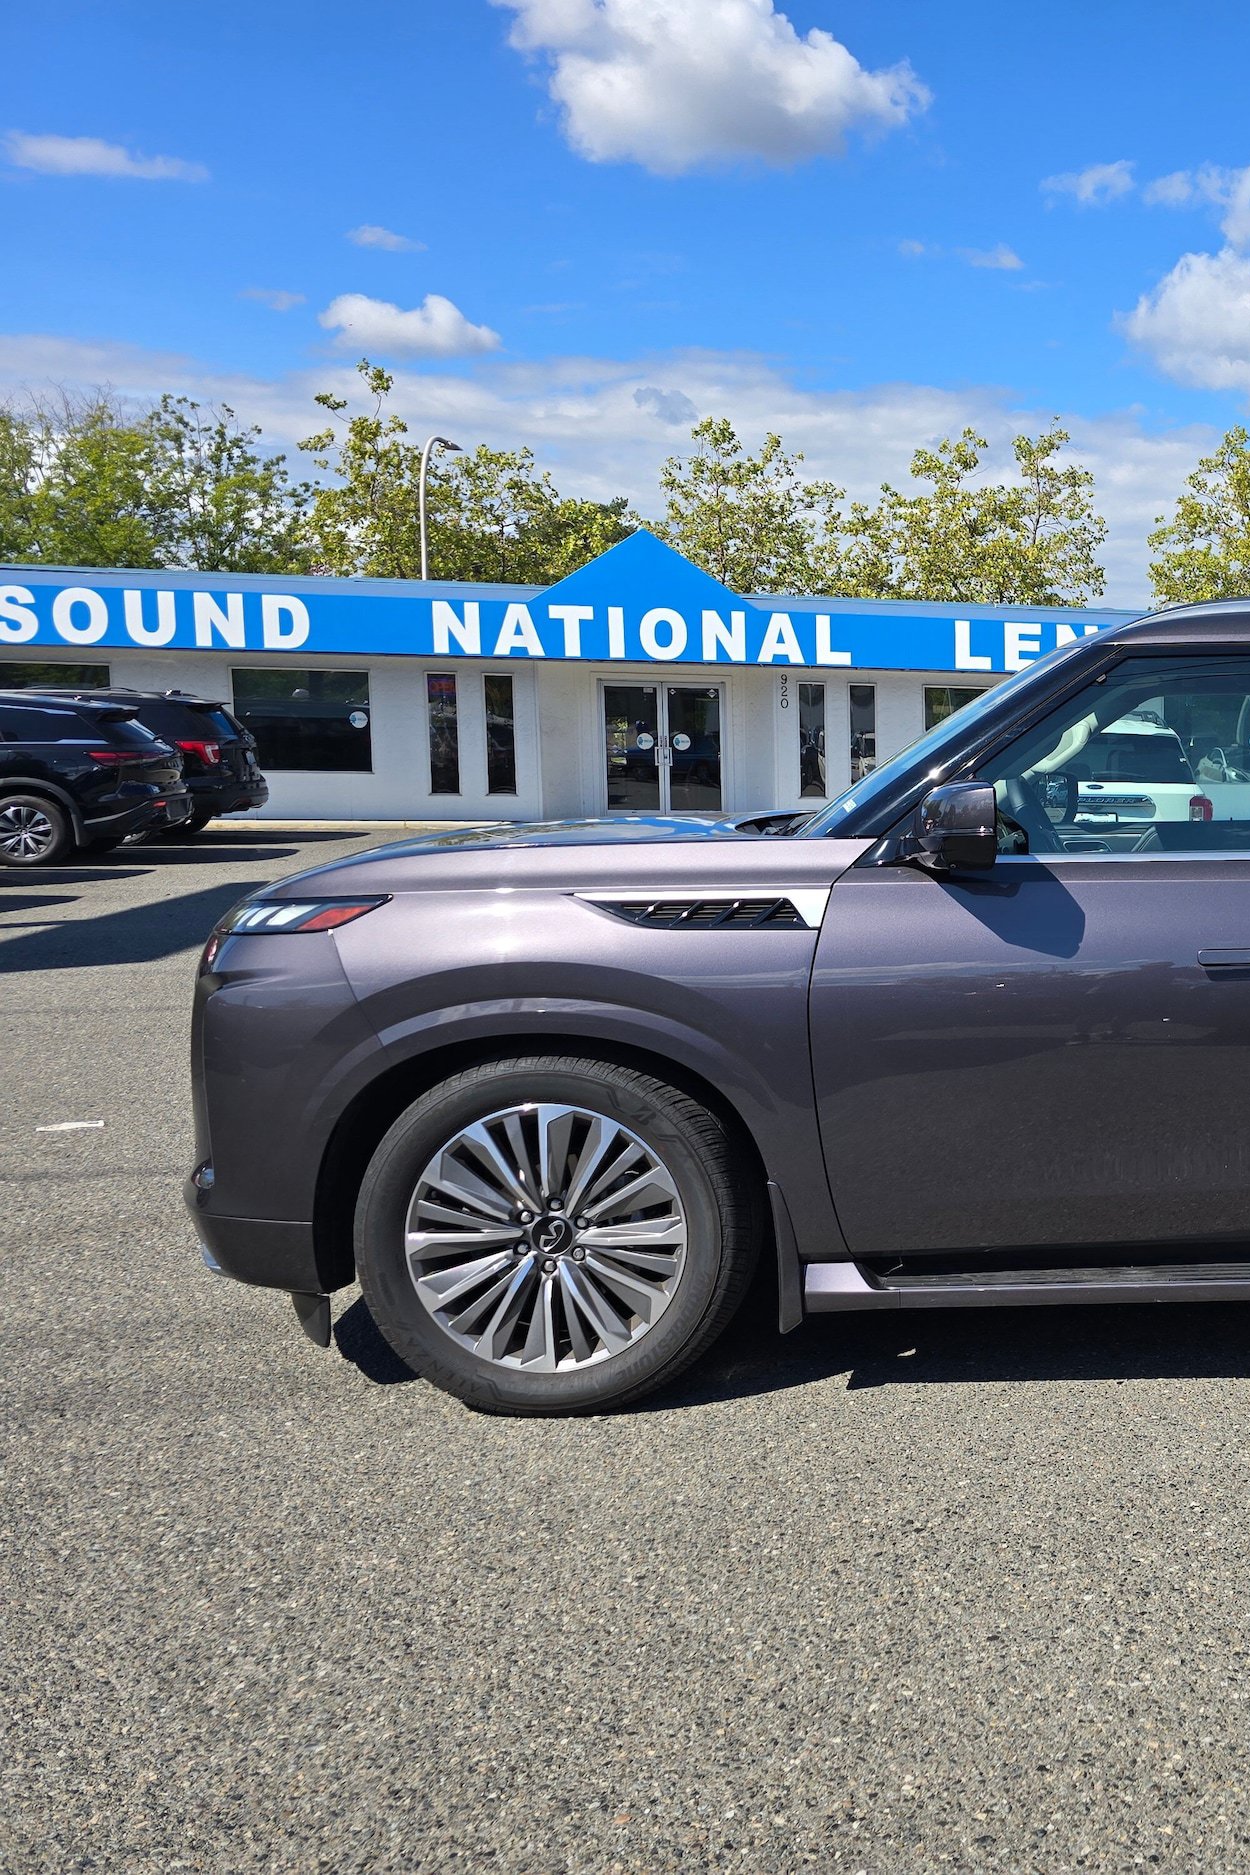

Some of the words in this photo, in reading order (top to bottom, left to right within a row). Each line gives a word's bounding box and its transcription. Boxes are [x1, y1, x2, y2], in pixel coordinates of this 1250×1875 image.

[0, 585, 311, 650] SOUND
[431, 600, 852, 666] NATIONAL
[780, 673, 789, 709] 920
